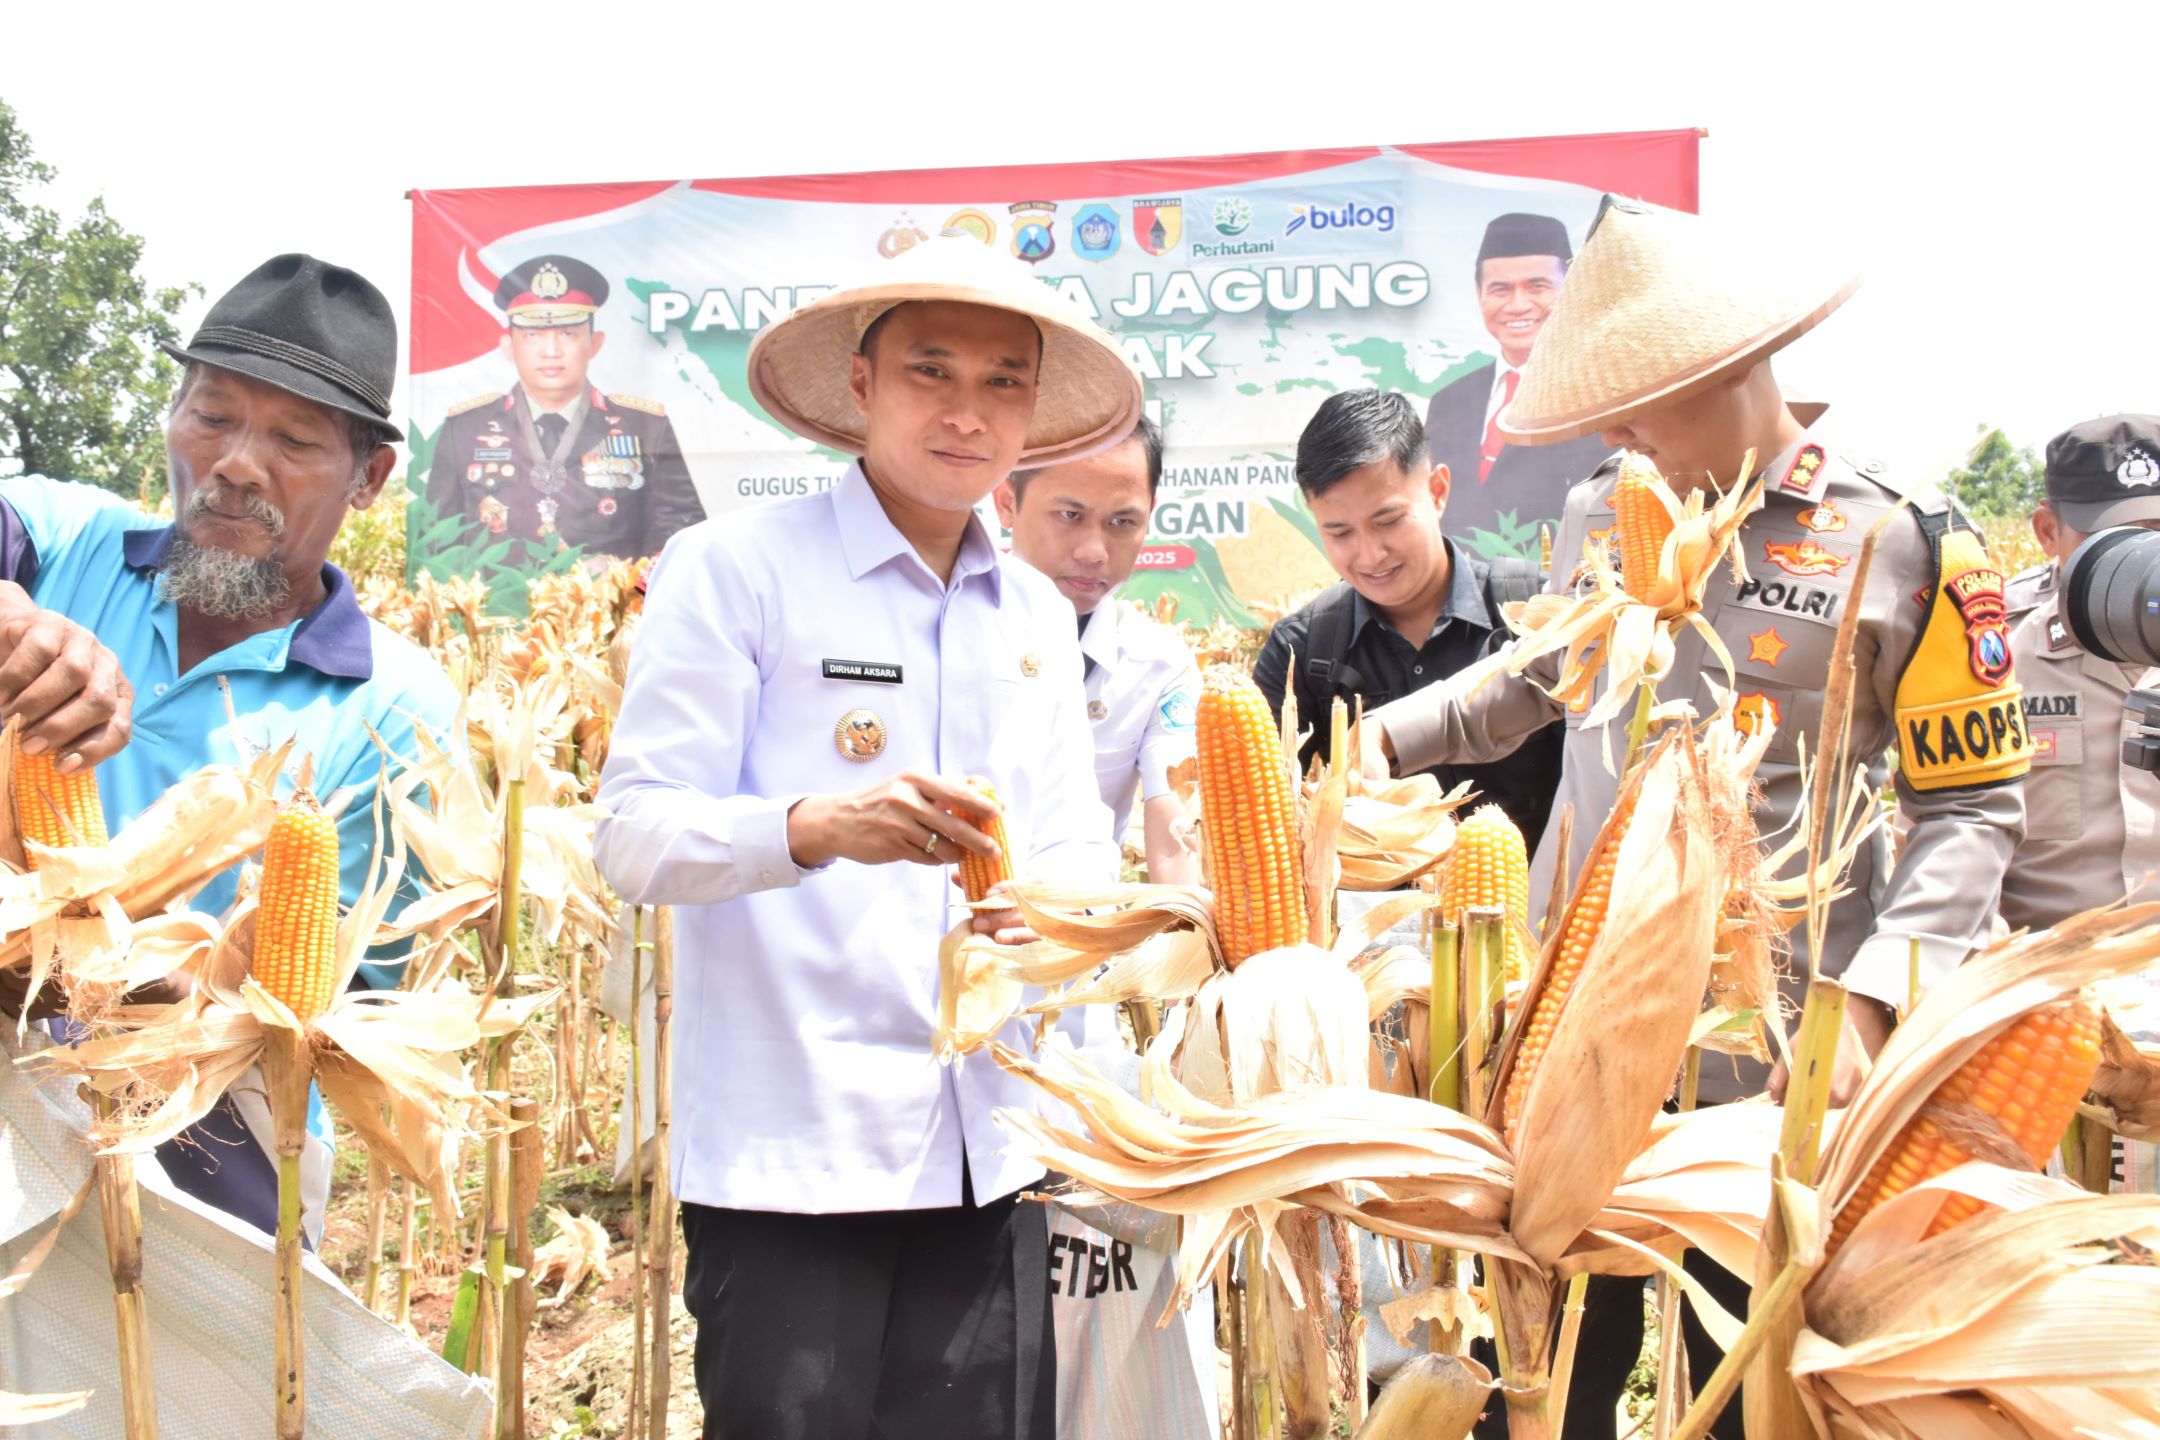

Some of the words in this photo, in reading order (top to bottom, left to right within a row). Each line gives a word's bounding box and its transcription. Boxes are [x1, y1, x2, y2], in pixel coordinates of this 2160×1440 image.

[1134, 198, 1181, 208] BRAWIJAYA
[1310, 202, 1394, 232] bulog
[1193, 239, 1274, 258] Perhutani
[1111, 261, 1430, 318] JAGUNG
[737, 477, 808, 496] GUGUS
[1148, 501, 1244, 535] GAN
[1737, 578, 1838, 619] POLRI
[829, 664, 862, 675] DIRHAM
[864, 667, 897, 678] AKSARA
[1909, 700, 2030, 768] KAOPS
